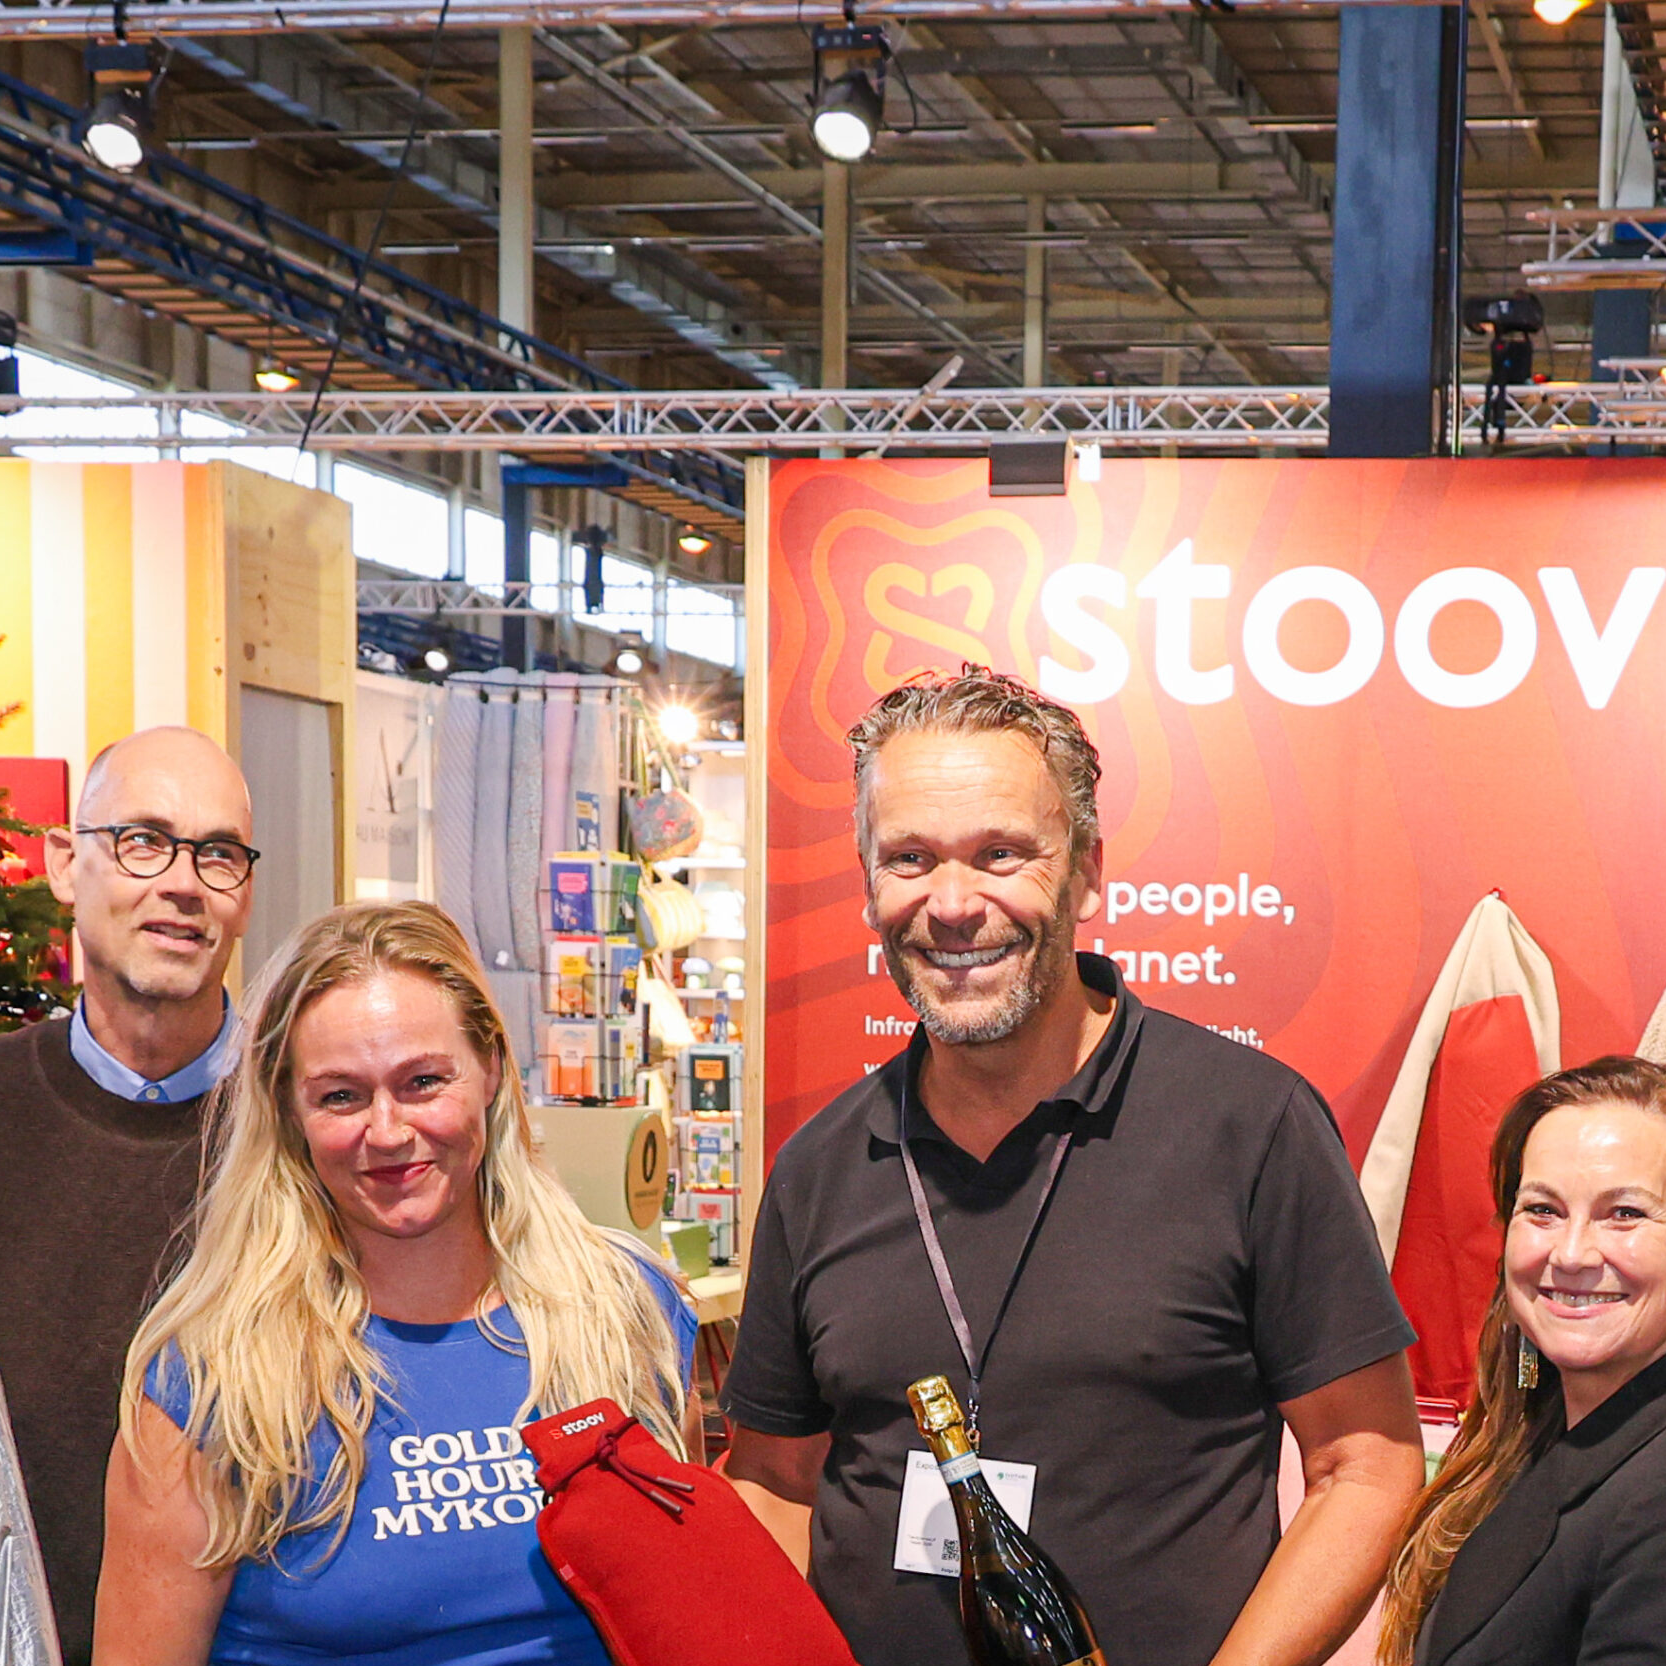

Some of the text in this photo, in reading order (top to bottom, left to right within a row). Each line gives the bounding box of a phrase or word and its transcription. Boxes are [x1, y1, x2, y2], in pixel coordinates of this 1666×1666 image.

[1039, 537, 1666, 710] stoov
[1107, 872, 1295, 926] people,
[1093, 937, 1236, 985] anet.
[390, 1422, 533, 1468] GOLD
[561, 1411, 606, 1436] stoov
